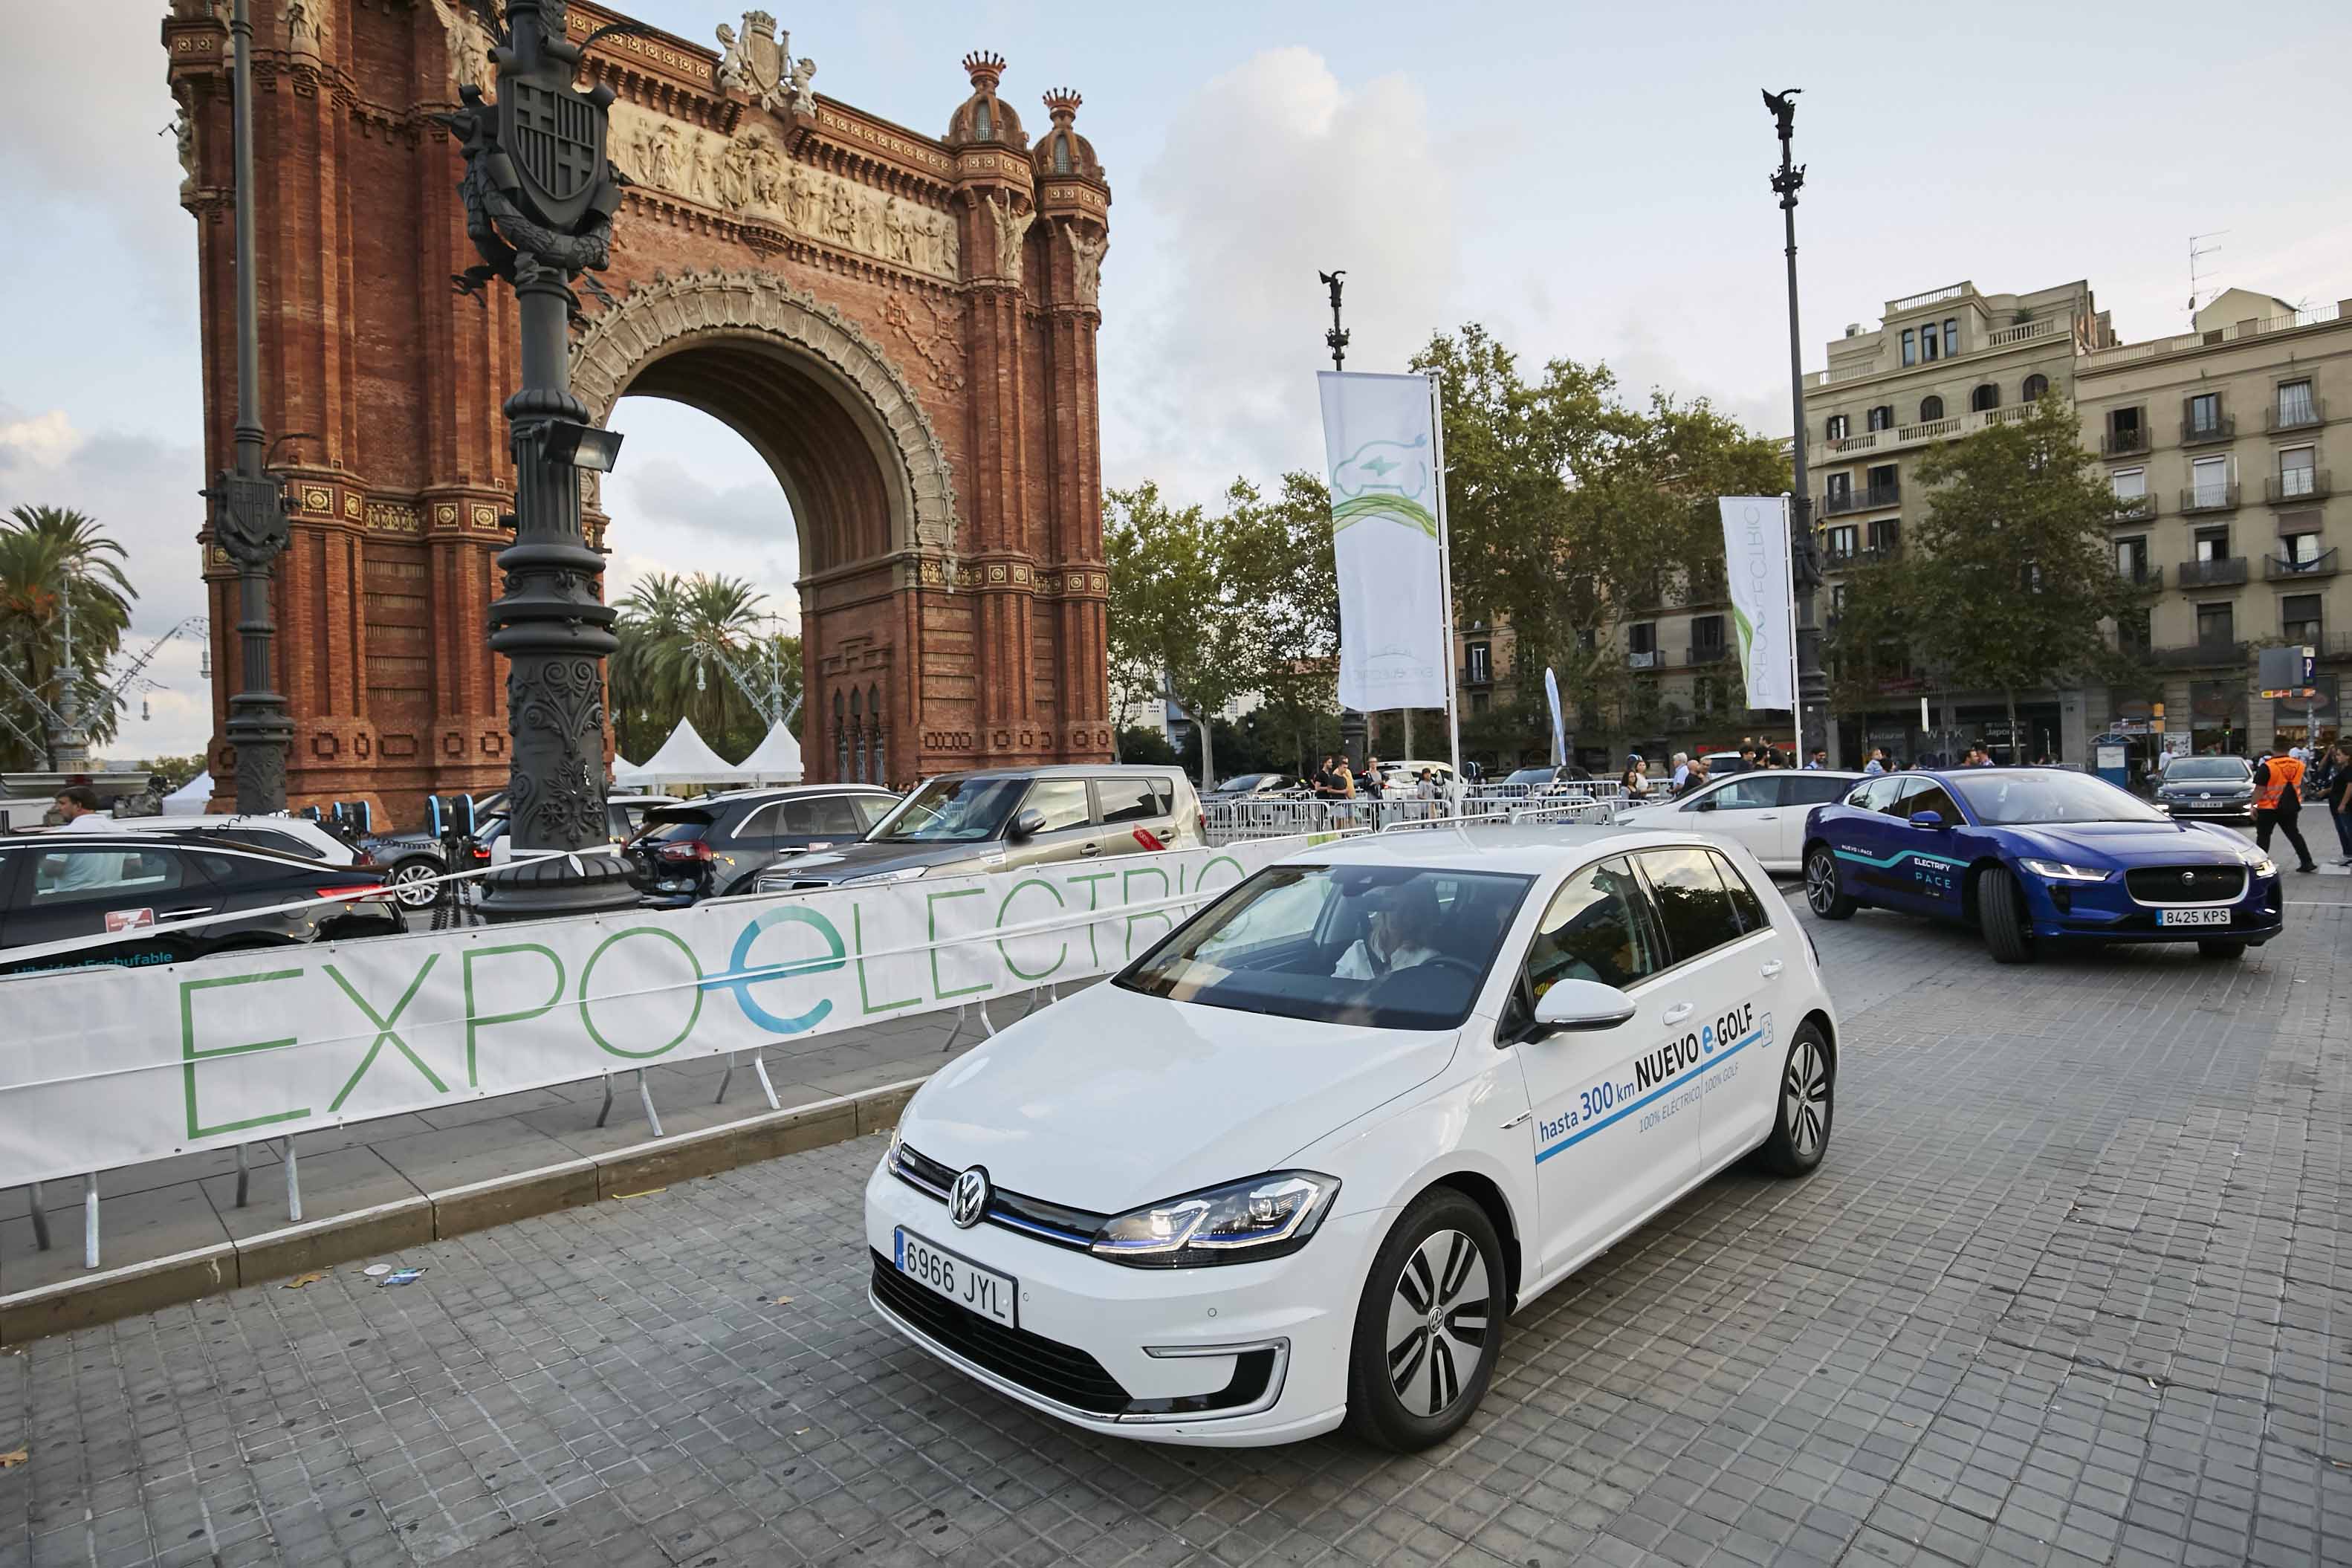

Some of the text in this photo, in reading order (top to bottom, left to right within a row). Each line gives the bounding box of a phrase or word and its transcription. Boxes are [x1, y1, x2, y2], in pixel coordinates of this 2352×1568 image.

[2306, 658, 2313, 677] P
[1914, 858, 1951, 872] ELECTRIFY
[2166, 910, 2227, 924] 8425 KPS
[1540, 1111, 1579, 1142] hasta
[1581, 1081, 1613, 1121] 300
[1616, 1082, 1636, 1103] km
[1635, 1033, 1699, 1092] NUEVO
[1639, 1111, 1661, 1133] 100%
[1704, 1075, 1722, 1094] 100%
[1723, 1062, 1739, 1083] GOLF
[907, 1242, 1005, 1318] 6966 JYL
